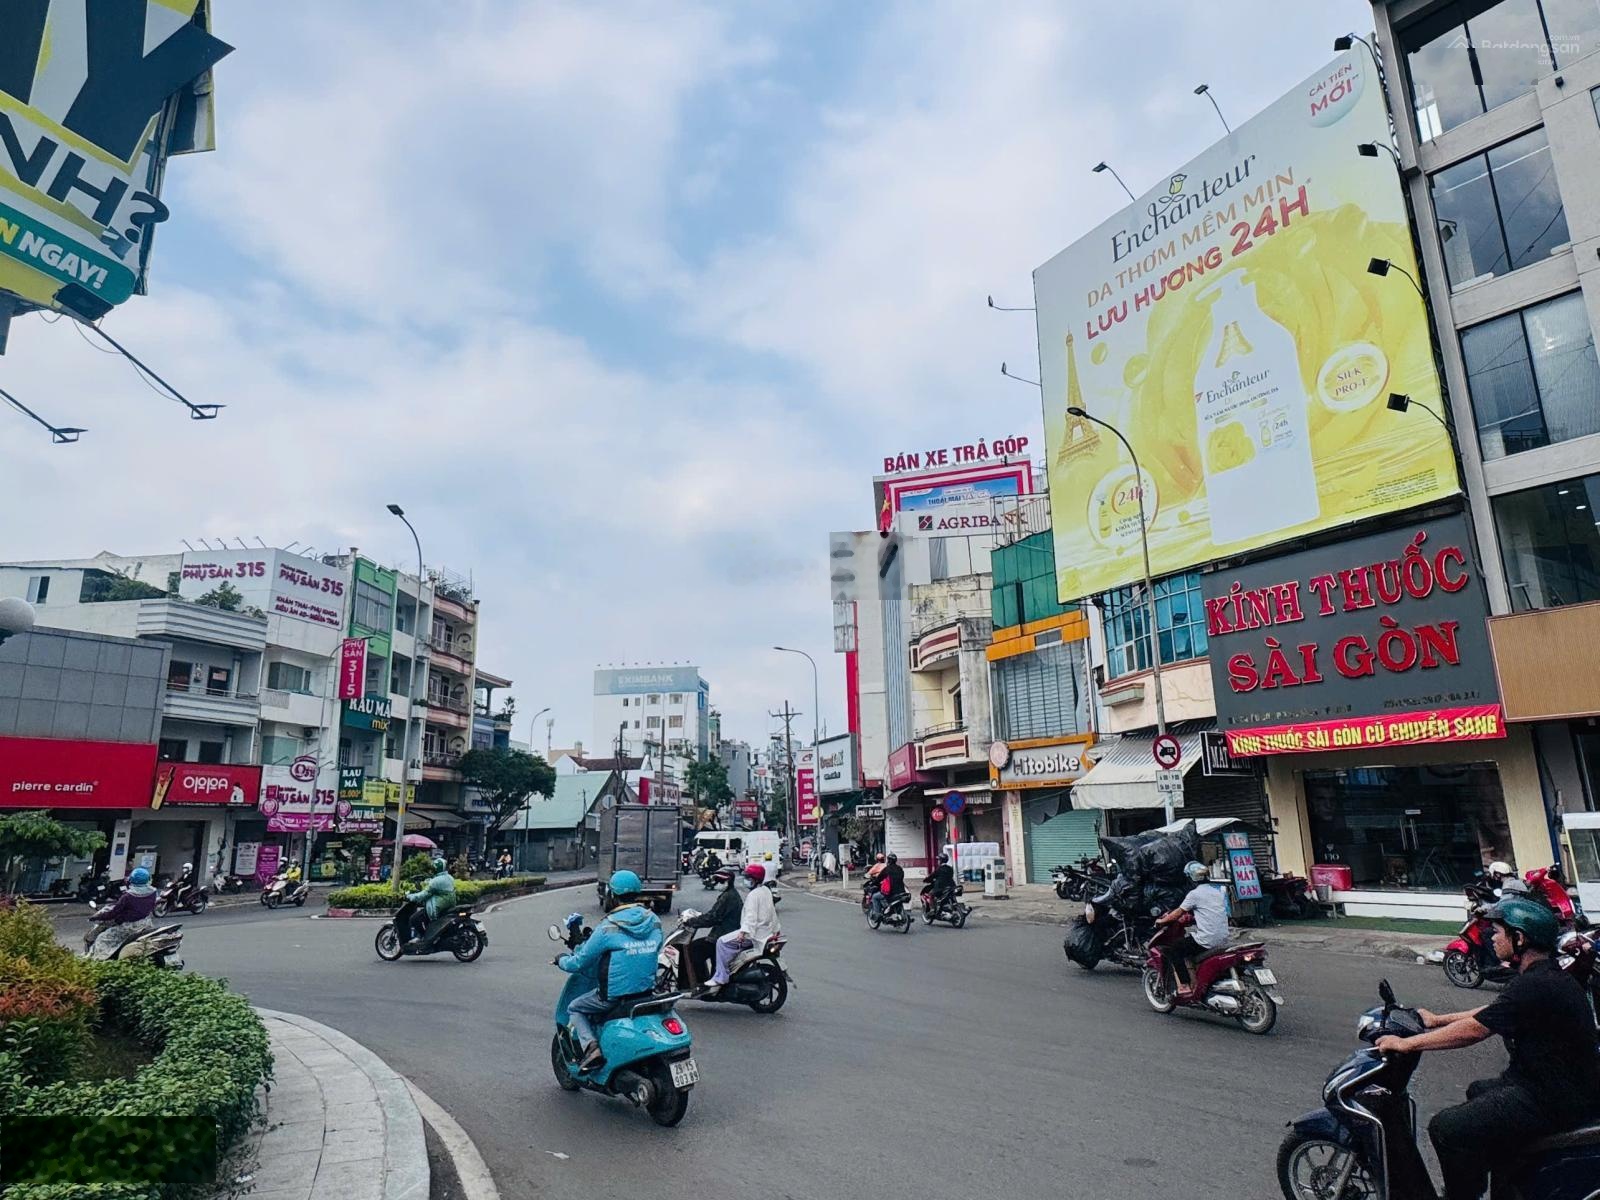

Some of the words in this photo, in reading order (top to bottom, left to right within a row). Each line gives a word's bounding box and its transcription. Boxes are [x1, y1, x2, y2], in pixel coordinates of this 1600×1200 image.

[1111, 154, 1256, 264] Enchanteur
[1087, 282, 1114, 308] DA
[1115, 240, 1177, 289] THƠM
[1181, 202, 1238, 251] MỀM
[1243, 166, 1296, 213] MỊN
[17, 230, 109, 290] NGAY!
[1086, 300, 1129, 340] LƯU
[1134, 246, 1224, 312] HƯƠNG
[1230, 184, 1310, 258] 24H
[1206, 369, 1271, 404] Enchanteur
[883, 452, 920, 474] BÁN
[925, 449, 948, 467] XE
[953, 437, 990, 464] TRẢ
[992, 434, 1029, 456] GÓP
[937, 512, 1029, 530] AGRIBANK
[183, 569, 208, 581] PHỤ
[208, 565, 233, 579] SẢN
[235, 561, 266, 578] 315
[321, 577, 344, 597] 315
[1204, 581, 1304, 637] KÍNH
[1308, 531, 1469, 616] THUỐC
[344, 648, 363, 658] SẢN
[345, 640, 364, 650] PHỤ
[1228, 636, 1324, 693] SÀI
[1332, 615, 1461, 680] GÒN
[618, 674, 673, 685] EXIMBANK
[375, 700, 391, 718] MÁ
[372, 719, 391, 730] mix
[1231, 735, 1260, 754] KÍNH
[1264, 726, 1303, 751] THUỐC
[1307, 724, 1330, 748] SÀI
[1332, 723, 1363, 746] GÒN
[1365, 721, 1387, 743] CŨ
[1388, 712, 1451, 740] CHUYỂN
[1453, 714, 1498, 737] SANG
[342, 769, 362, 777] RAU
[1013, 753, 1080, 776] Hitobike
[12, 781, 52, 792] pierre
[54, 782, 94, 792] cardin
[344, 778, 358, 788] MÁ
[1236, 866, 1256, 881] MÁT
[1240, 885, 1260, 897] GAN
